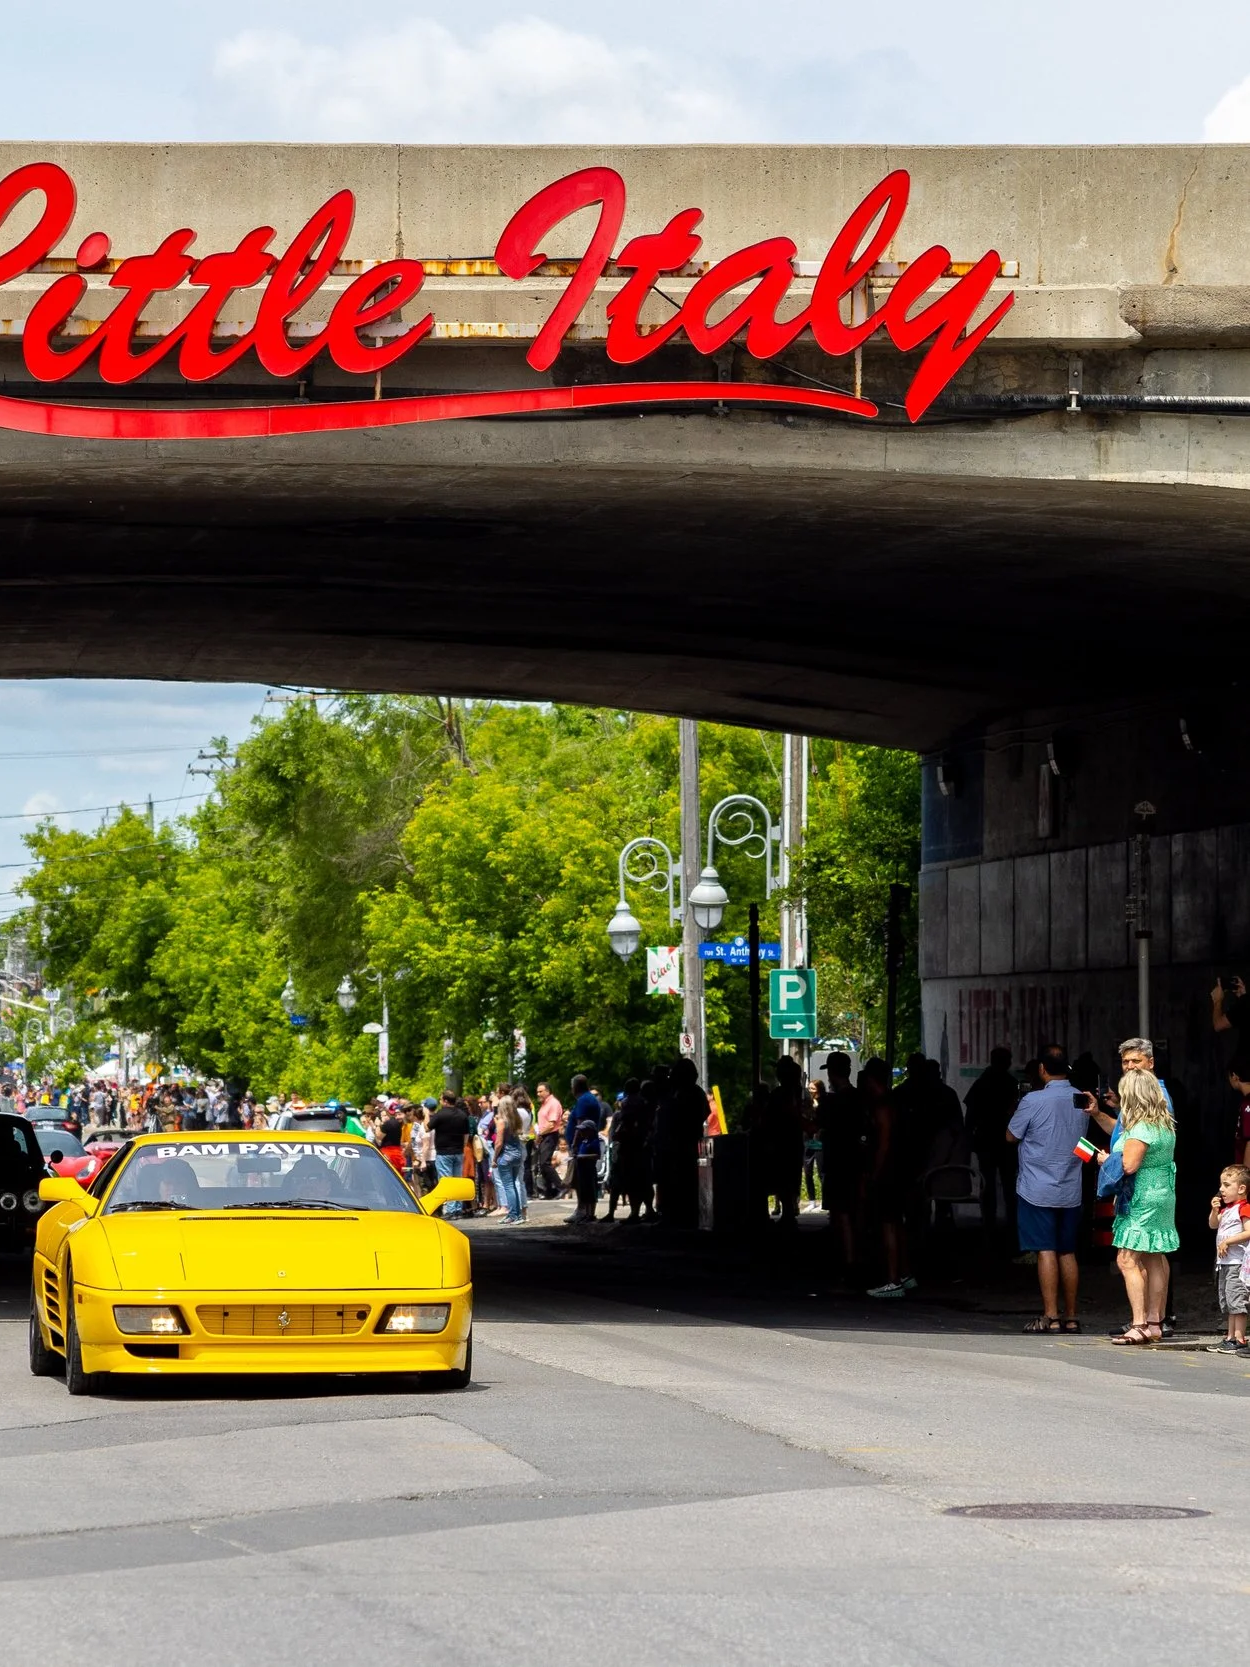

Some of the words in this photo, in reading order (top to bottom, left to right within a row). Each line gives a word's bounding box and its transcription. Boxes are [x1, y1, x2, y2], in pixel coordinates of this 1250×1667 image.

[494, 166, 1014, 423] Italy
[715, 946, 727, 956] St.
[651, 955, 676, 984] Ciao!
[779, 974, 807, 1011] P
[157, 1144, 230, 1158] BAM
[239, 1143, 361, 1158] PAVING
